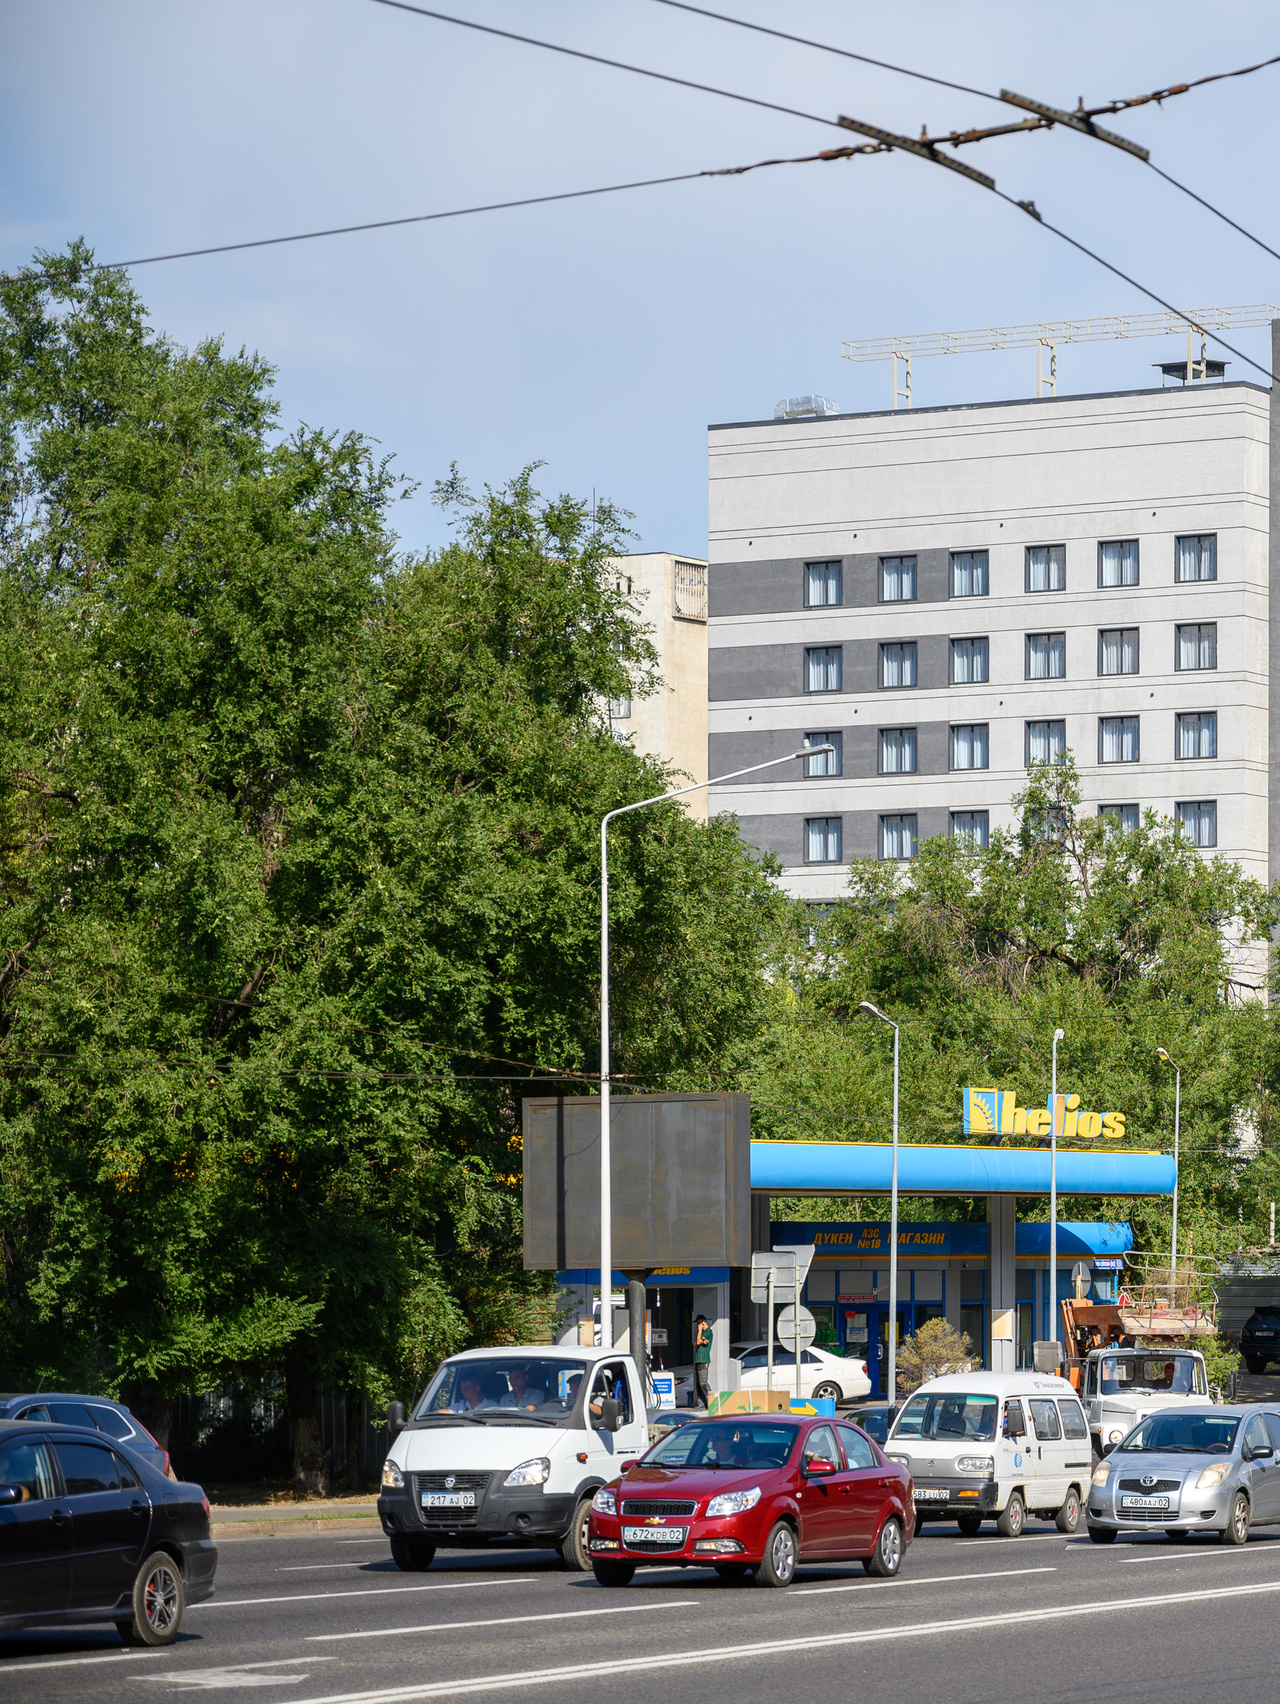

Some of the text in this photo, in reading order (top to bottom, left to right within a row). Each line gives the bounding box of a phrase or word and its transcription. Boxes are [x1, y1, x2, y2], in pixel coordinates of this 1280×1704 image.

[1000, 1090, 1126, 1139] helios
[861, 1228, 880, 1239] АЗС
[856, 1239, 881, 1249] №18
[430, 1495, 446, 1505] 217
[463, 1495, 474, 1505] 02
[940, 1491, 948, 1499] 02
[632, 1529, 667, 1539] 672KDB
[669, 1530, 681, 1540] 02
